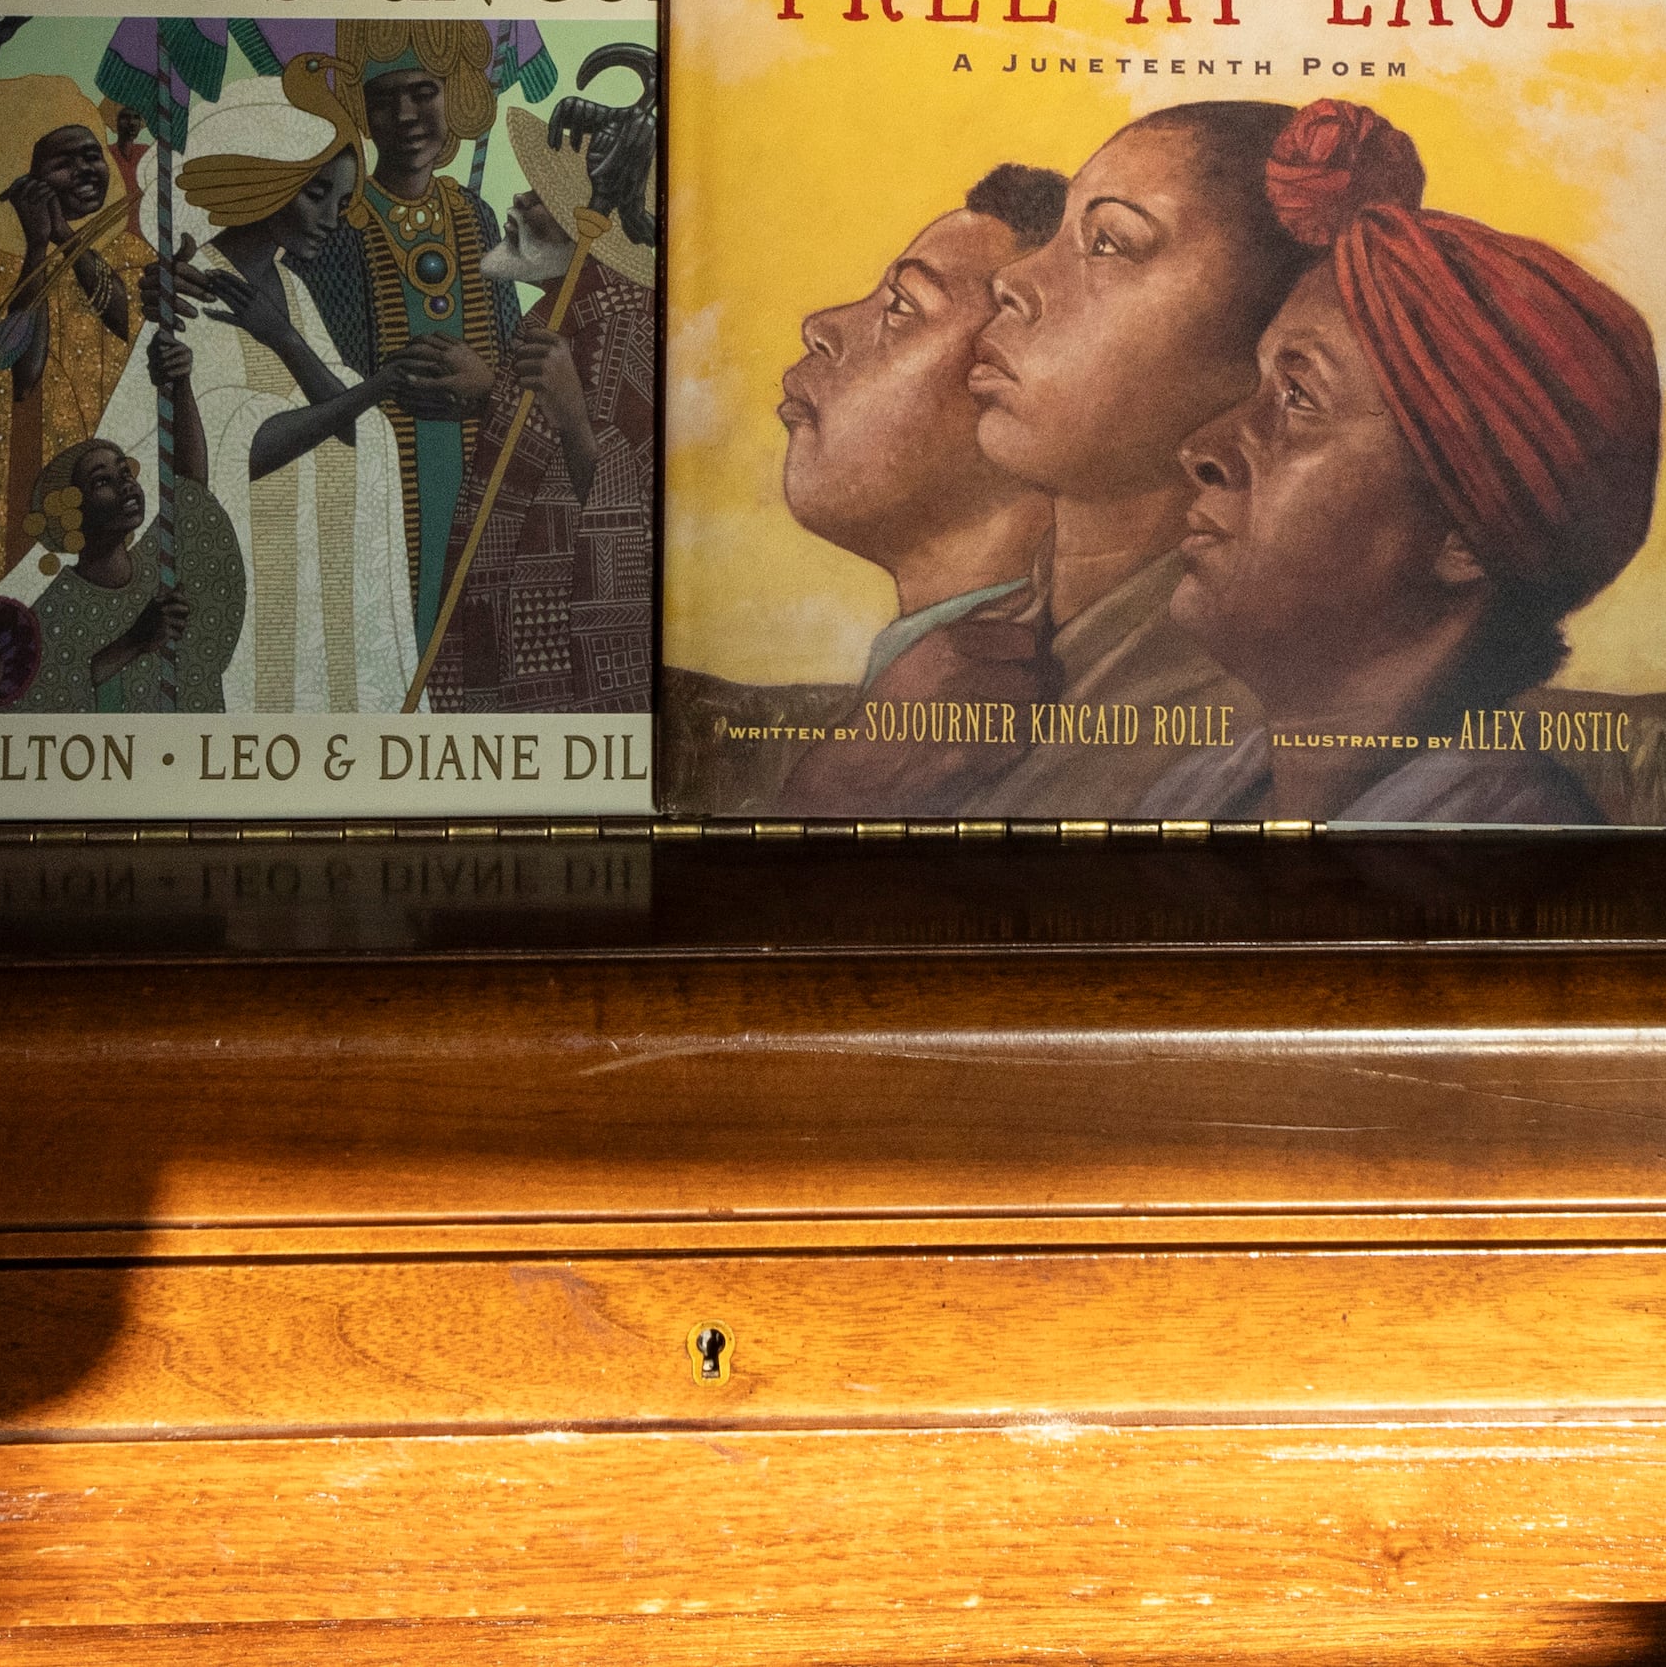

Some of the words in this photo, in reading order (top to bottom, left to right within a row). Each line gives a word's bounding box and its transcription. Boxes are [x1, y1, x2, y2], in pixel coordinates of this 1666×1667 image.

[952, 53, 974, 73] A
[728, 726, 826, 740] WRITTEN
[834, 729, 859, 741] BY
[866, 701, 1016, 744] SOJOURNER
[1030, 704, 1138, 746] KINCAID
[1153, 705, 1234, 747] ROLLE
[1272, 735, 1419, 748] ILLUSTRATED
[1427, 736, 1453, 749] BY
[1459, 710, 1526, 751] ALEX
[1539, 710, 1630, 752] BOSTIC
[199, 736, 302, 782] LEO
[324, 738, 356, 780] &
[380, 736, 541, 782] DIANE
